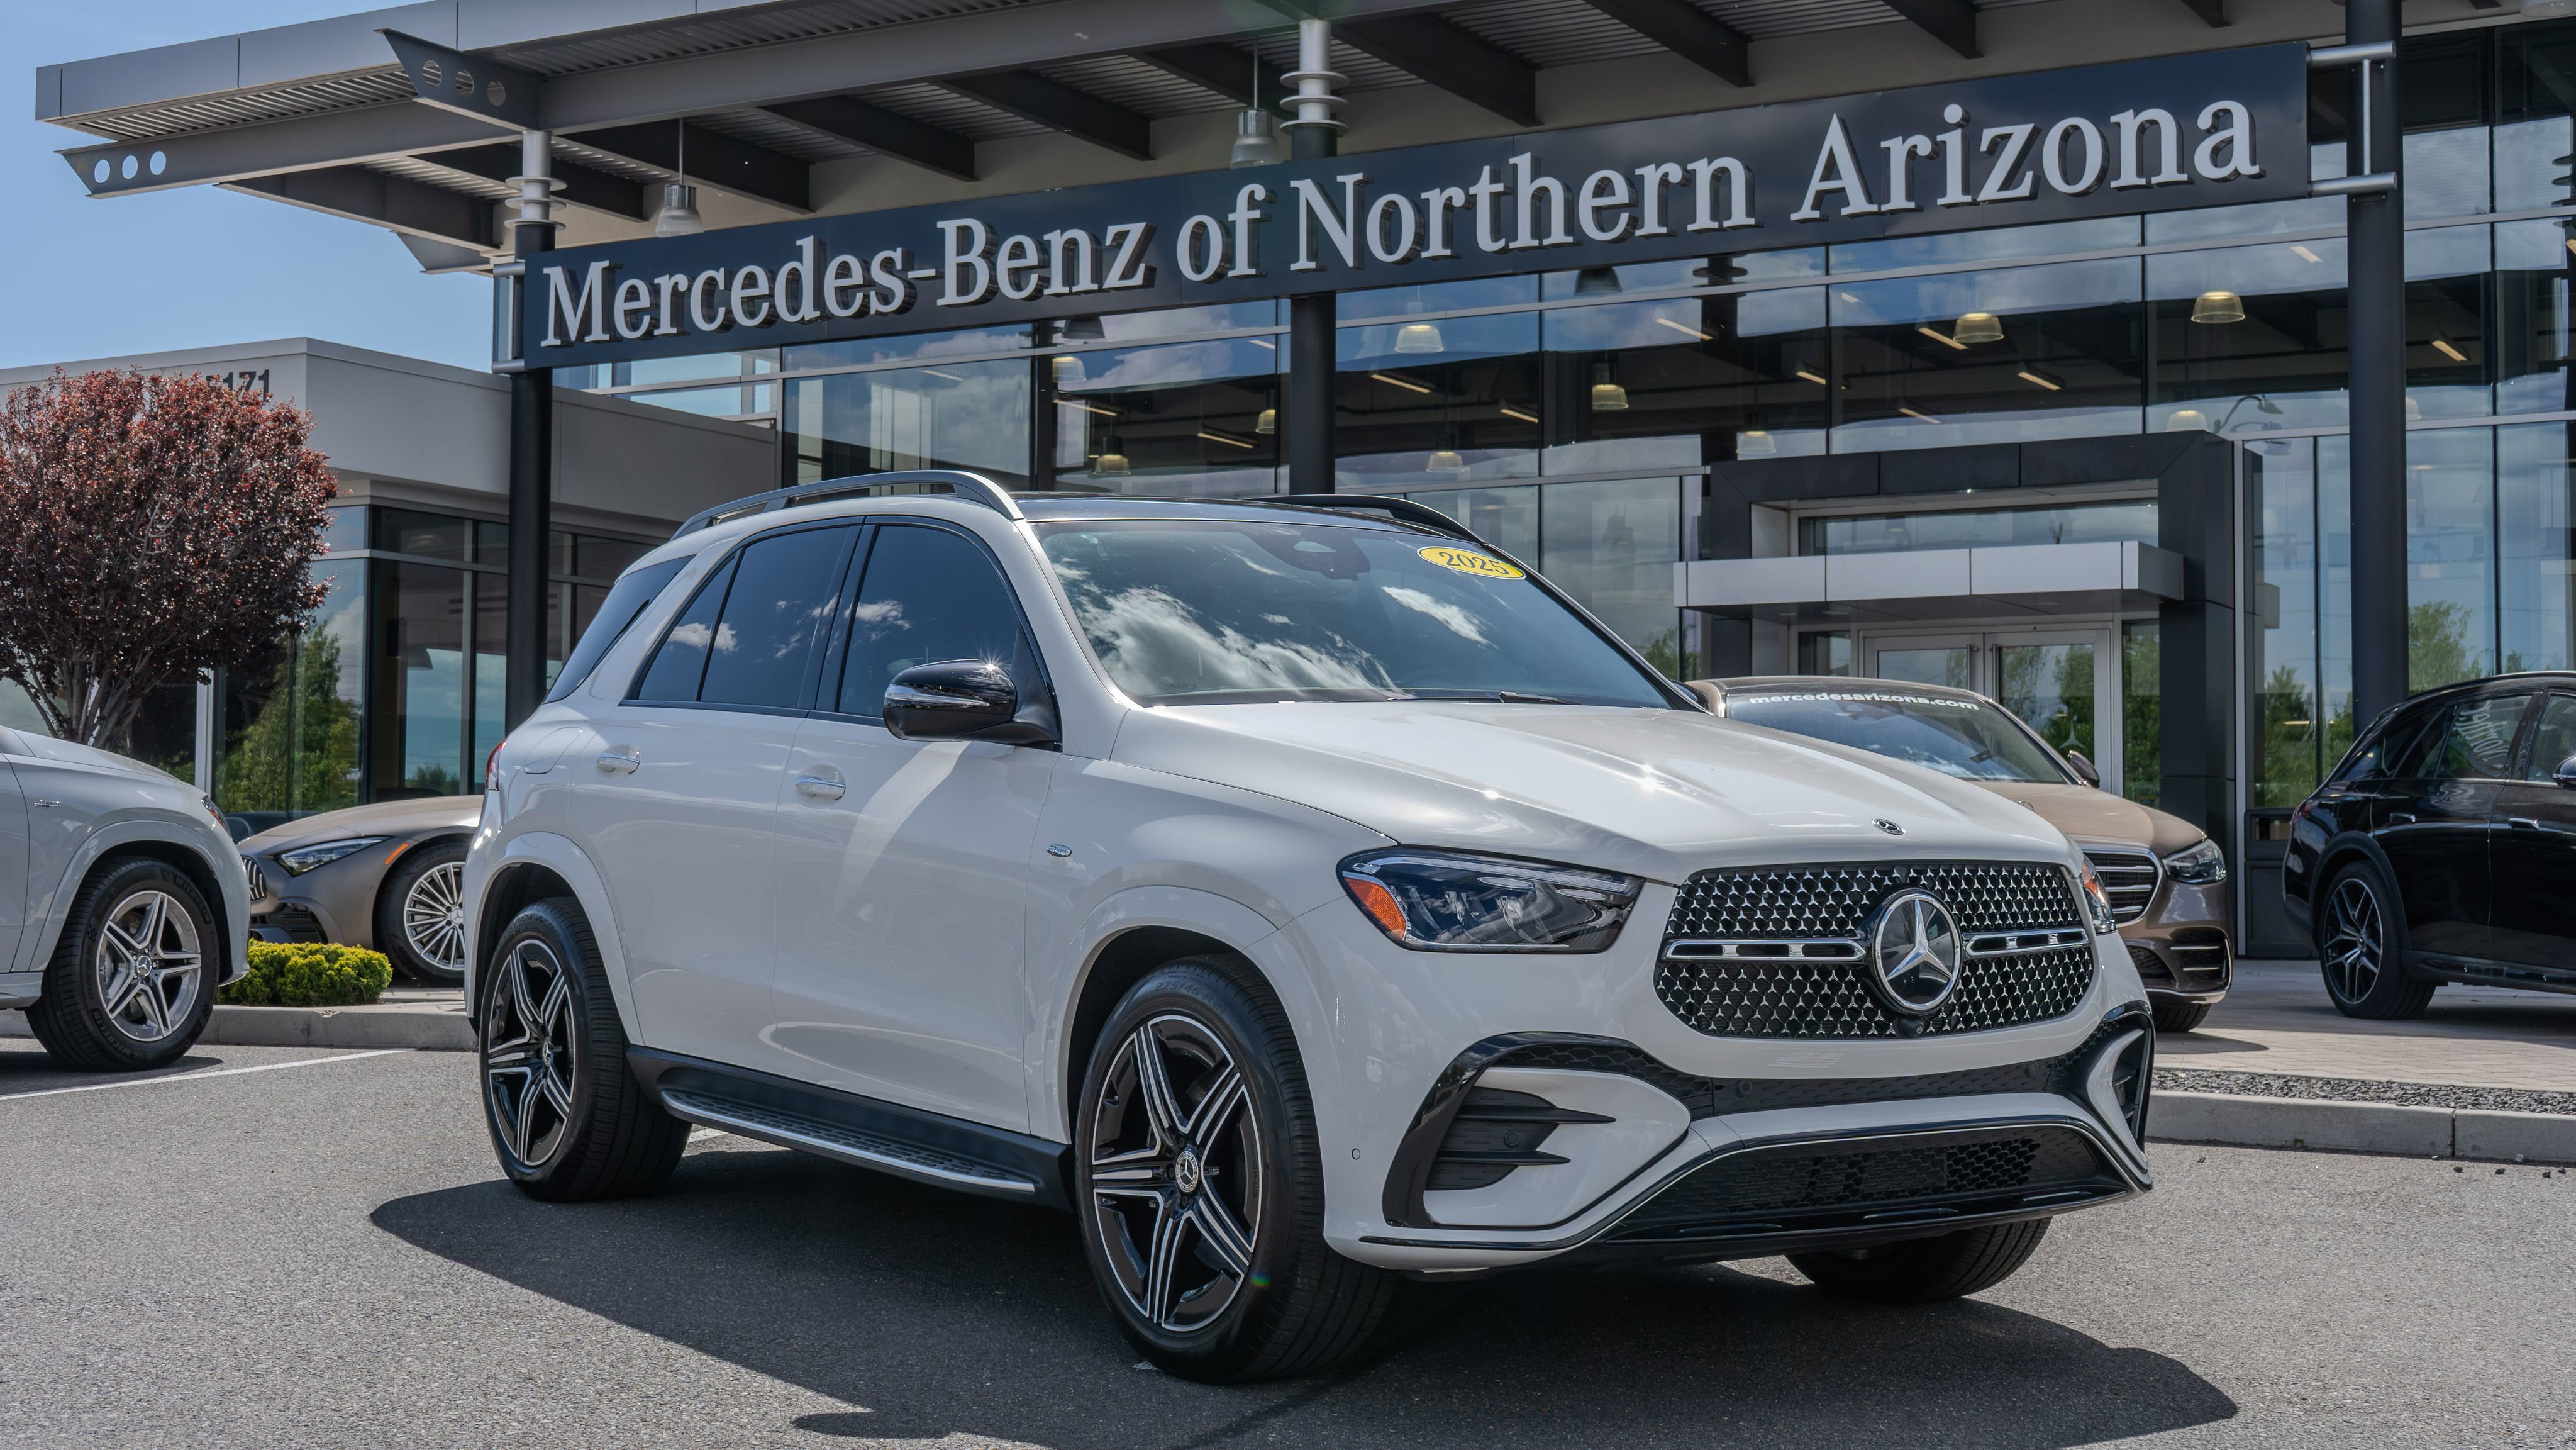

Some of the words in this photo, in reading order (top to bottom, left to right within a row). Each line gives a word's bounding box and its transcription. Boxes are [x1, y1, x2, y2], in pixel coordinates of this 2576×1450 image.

[541, 216, 1148, 349] Mercedes-Benz
[1176, 184, 1265, 283] of
[1289, 152, 1757, 273] Northern
[1790, 101, 2260, 222] Arizona
[1438, 552, 1509, 575] 2025
[1748, 693, 1979, 711] mercedesarizona.com
